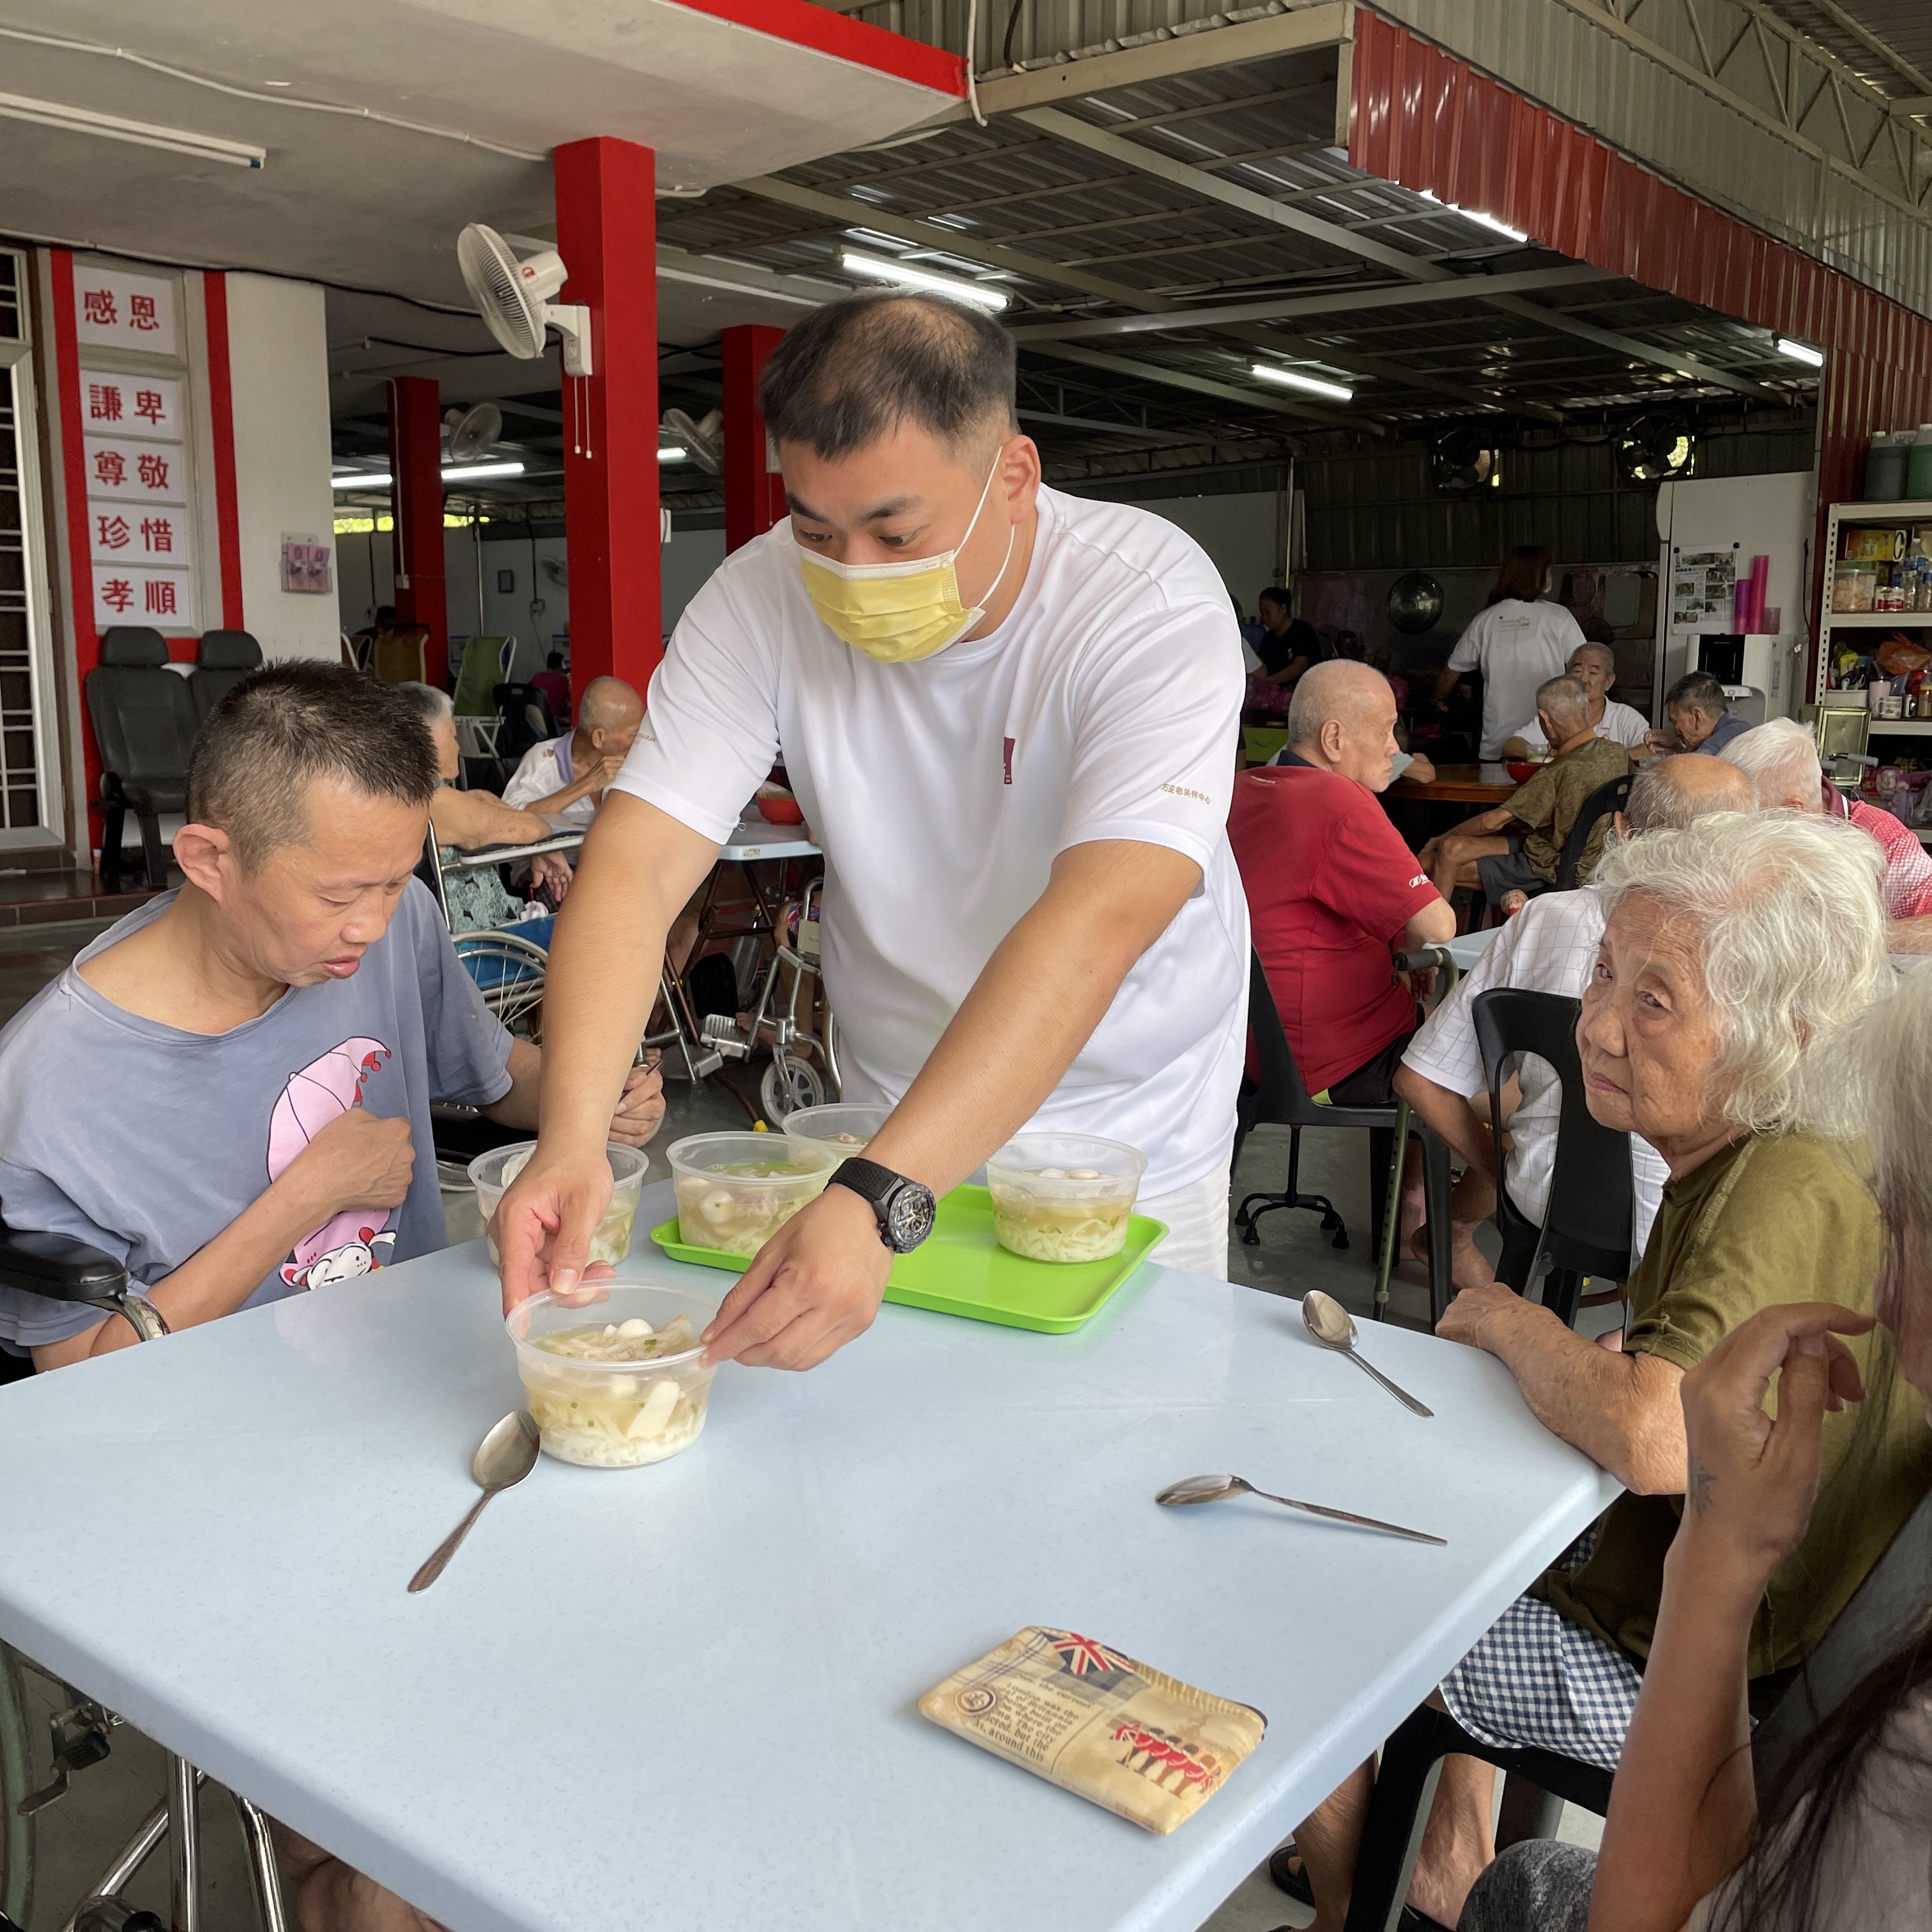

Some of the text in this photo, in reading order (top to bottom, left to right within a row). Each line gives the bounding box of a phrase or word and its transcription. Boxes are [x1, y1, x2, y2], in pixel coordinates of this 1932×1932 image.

[84, 289, 160, 330] 感恩
[89, 385, 166, 425] 謙卑
[94, 451, 169, 489] 尊敬
[96, 516, 172, 551] 珍惜
[102, 579, 177, 614] 孝順
[1046, 1724, 1062, 1736] the
[1063, 1709, 1080, 1721] the
[988, 1728, 1023, 1752] around
[1025, 1744, 1044, 1762] this
[1014, 1728, 1031, 1742] but
[1033, 1737, 1050, 1752] the
